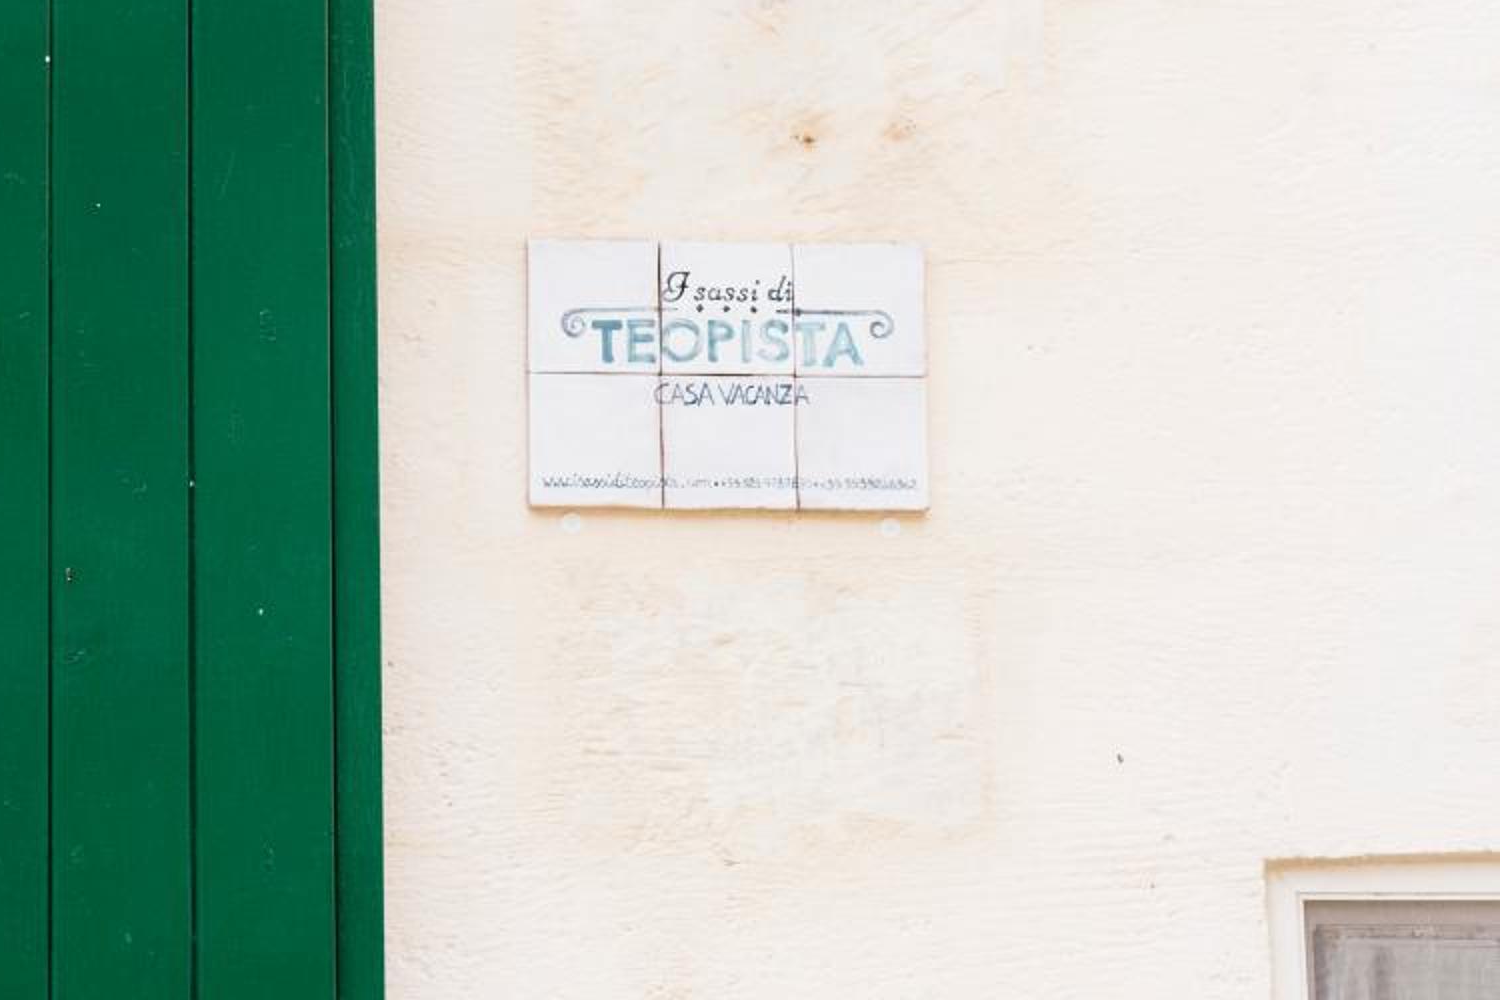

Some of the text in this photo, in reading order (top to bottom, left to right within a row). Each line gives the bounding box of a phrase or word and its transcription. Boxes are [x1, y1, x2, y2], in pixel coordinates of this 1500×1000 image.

[694, 279, 759, 301] sassi
[767, 275, 792, 302] di
[591, 317, 865, 368] TEOPISTA
[653, 382, 811, 406] CASA VACANZA
